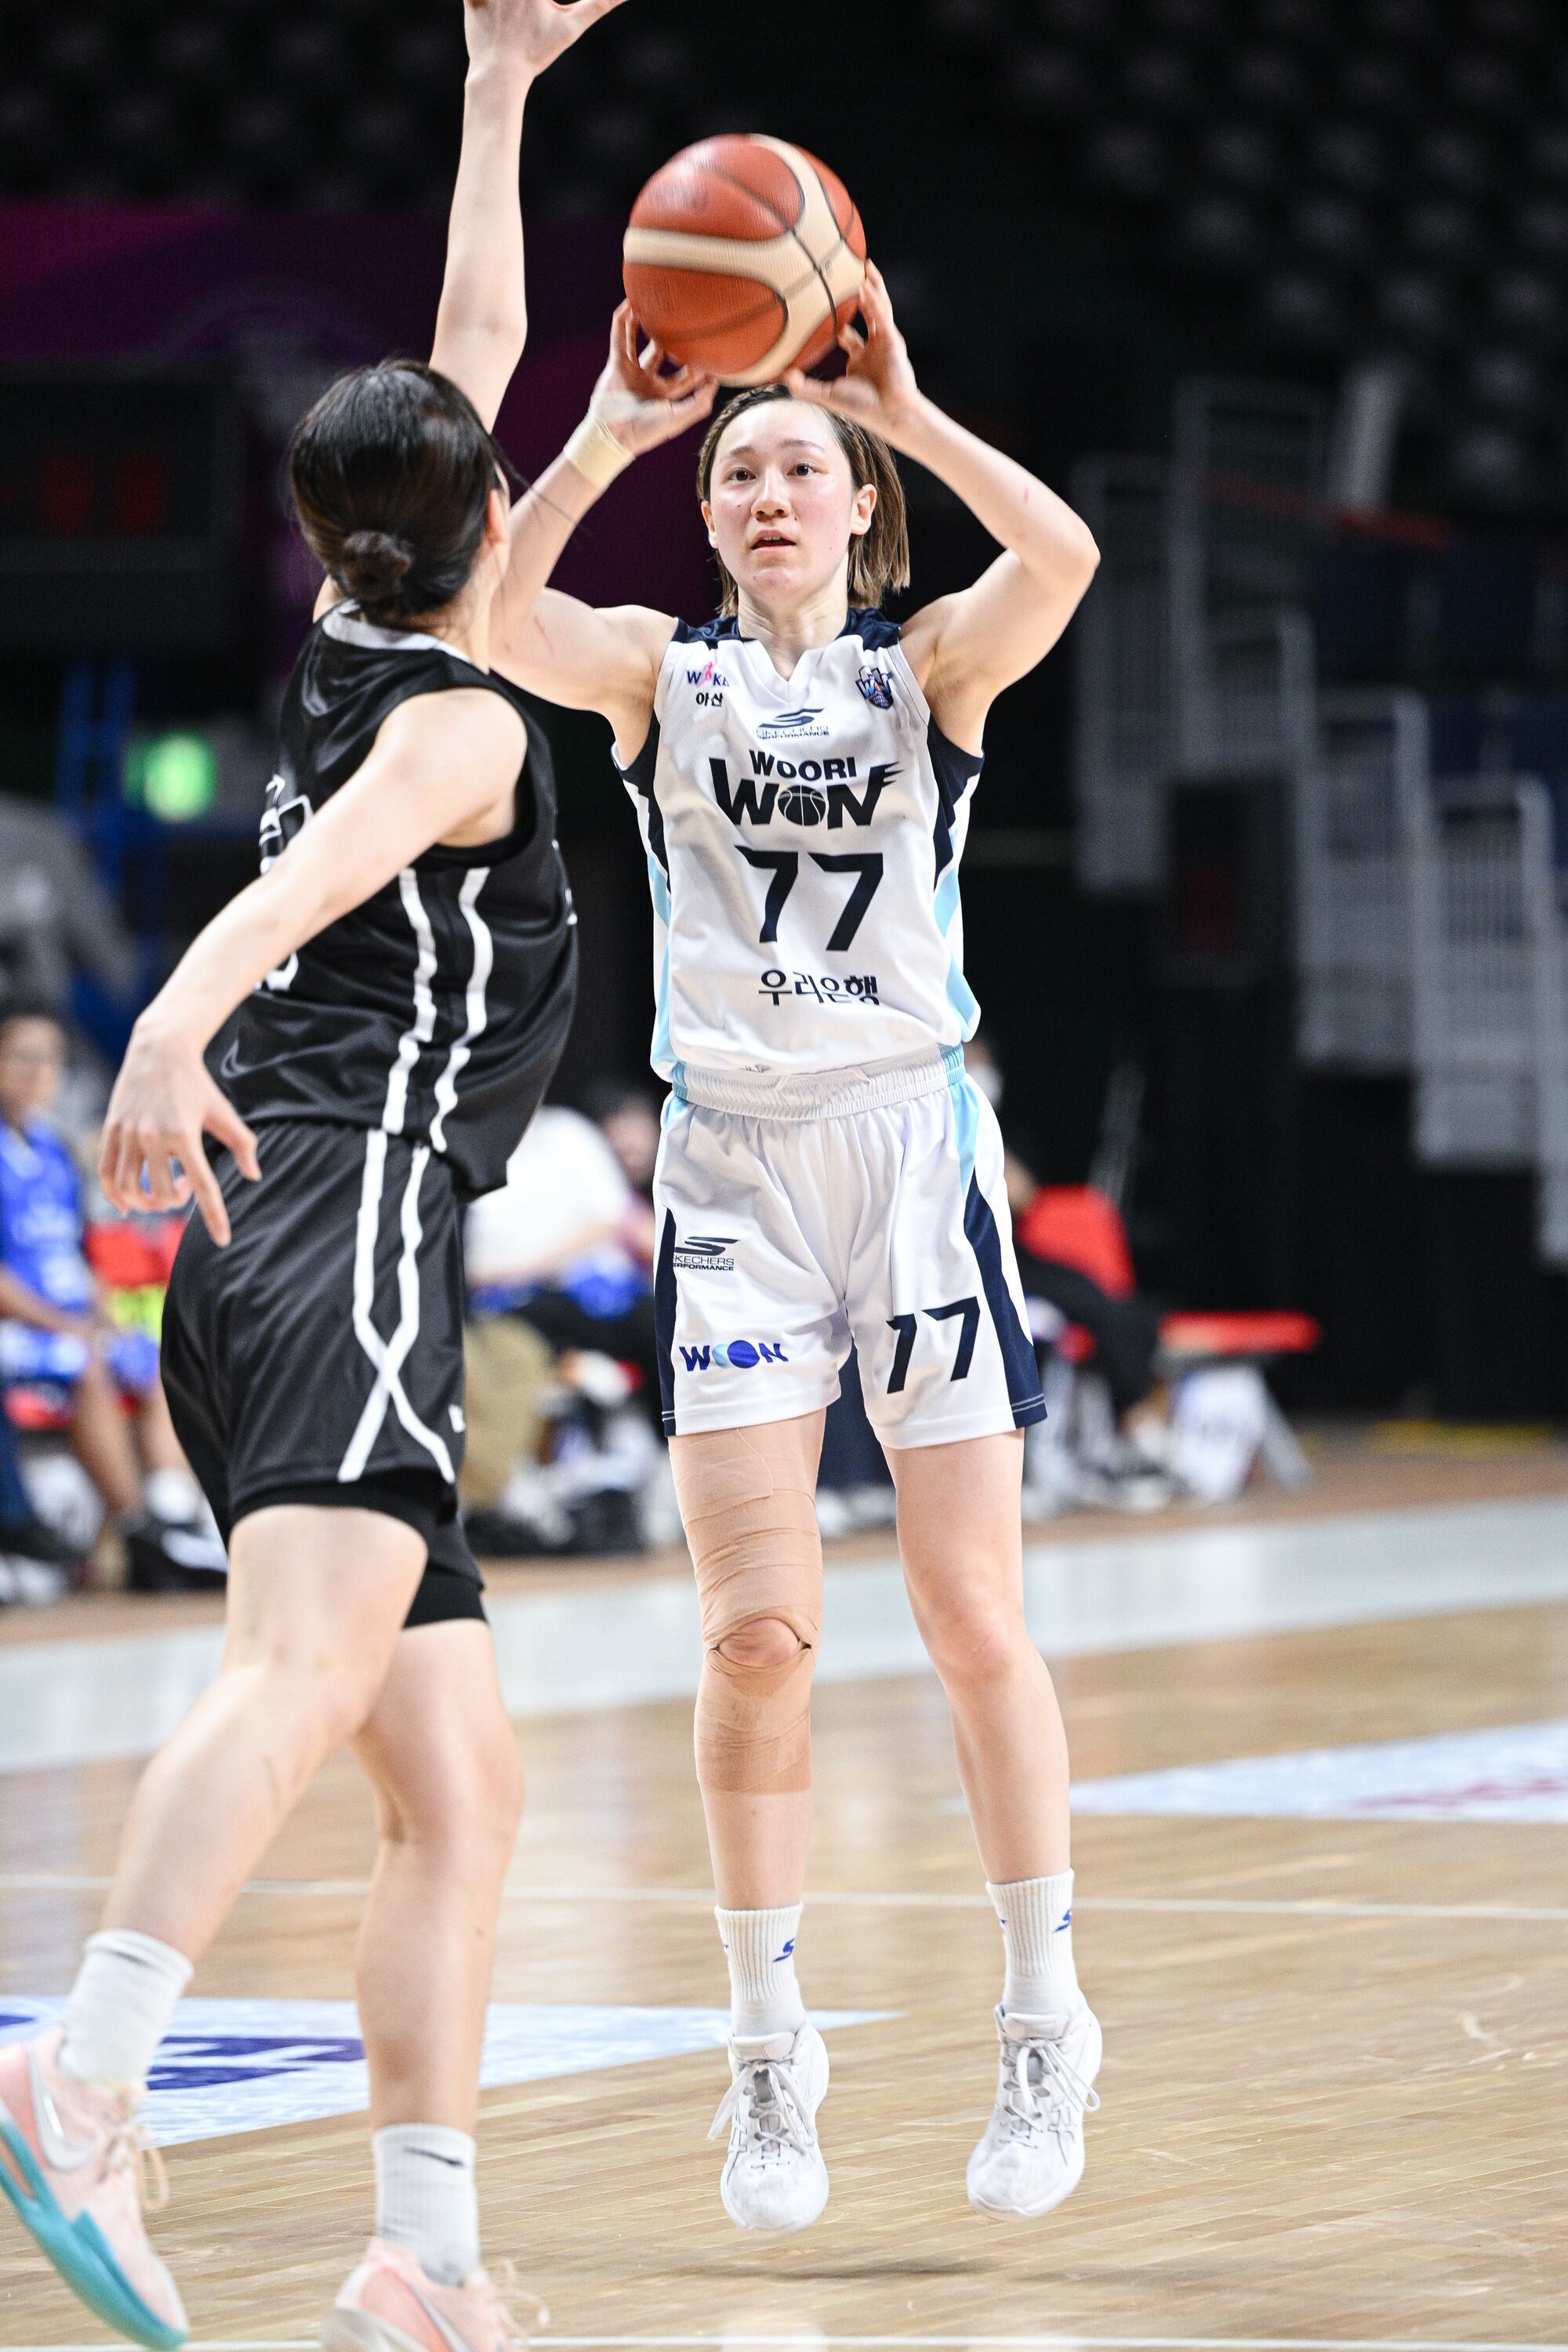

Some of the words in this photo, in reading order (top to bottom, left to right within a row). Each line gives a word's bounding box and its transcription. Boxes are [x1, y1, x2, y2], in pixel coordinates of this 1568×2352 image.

[695, 692, 724, 707] 아산
[749, 750, 857, 782] WOORI
[735, 845, 884, 952] 77
[758, 969, 880, 1006] 우리은행
[673, 1254, 735, 1266] KECHERS
[673, 1262, 735, 1272] ERFORMANCE
[885, 1296, 981, 1394] 77
